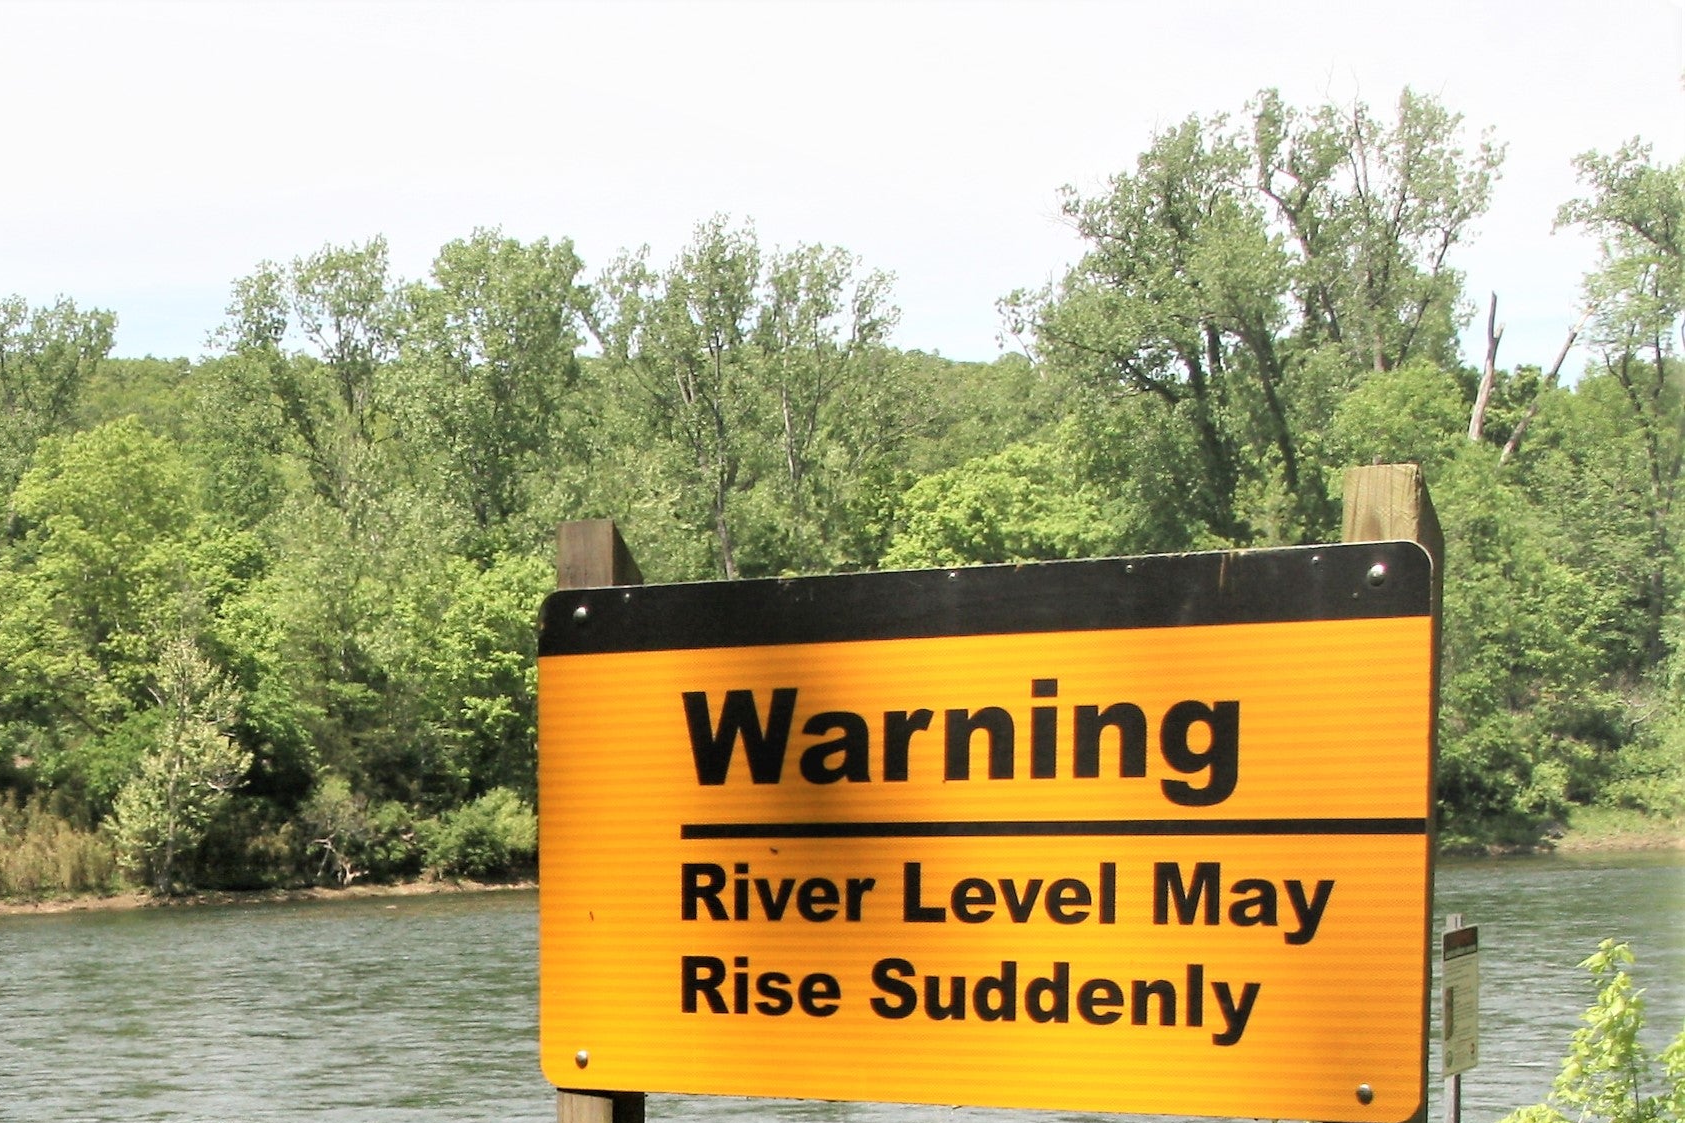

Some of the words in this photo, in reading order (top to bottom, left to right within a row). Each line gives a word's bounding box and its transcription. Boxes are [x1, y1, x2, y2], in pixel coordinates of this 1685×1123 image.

[681, 678, 1241, 806] Warning
[681, 861, 876, 923] River
[903, 861, 1117, 925] Level
[1154, 861, 1336, 945] May
[681, 955, 842, 1017] Rise
[870, 957, 1261, 1047] Suddenly
